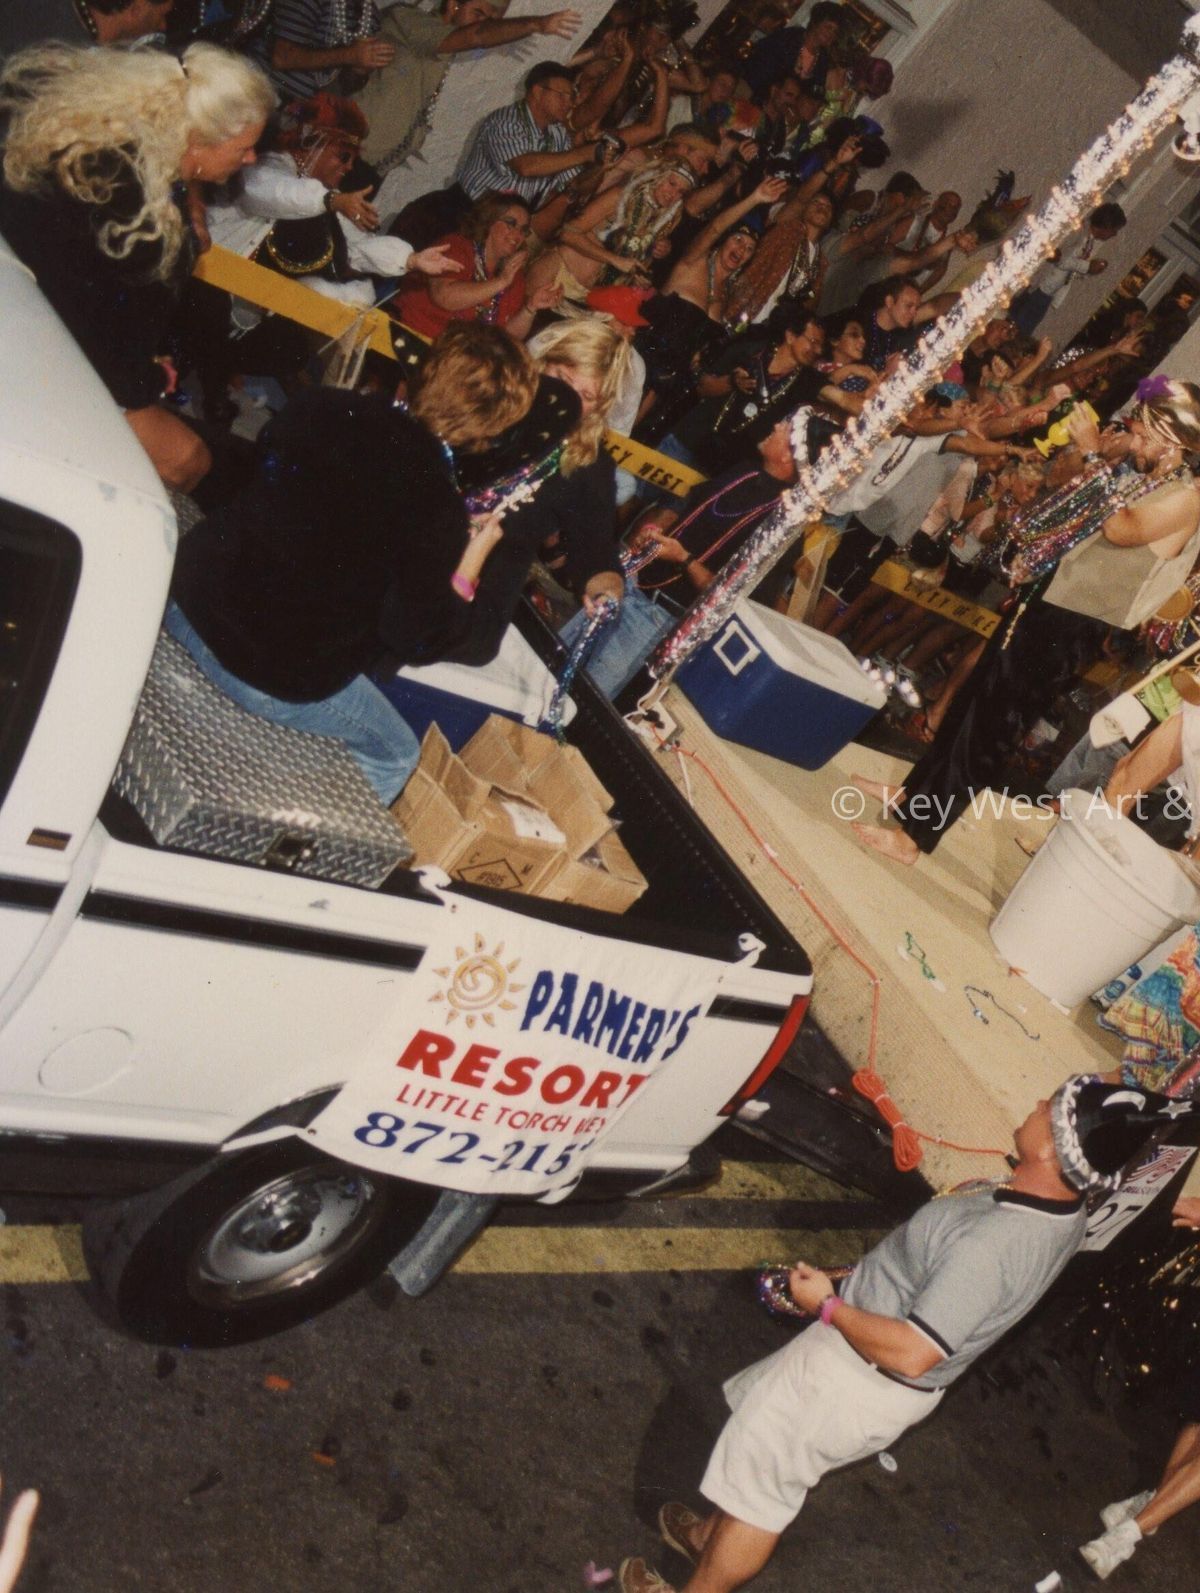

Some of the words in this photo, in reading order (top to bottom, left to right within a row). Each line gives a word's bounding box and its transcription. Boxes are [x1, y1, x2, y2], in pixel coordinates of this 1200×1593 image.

[638, 462, 684, 490] WEST
[520, 969, 702, 1064] PARMER'S
[396, 1028, 651, 1110] RESORT
[396, 1083, 488, 1122] LITTLE
[495, 1106, 572, 1134] TORCH
[353, 1111, 596, 1176] 872-215
